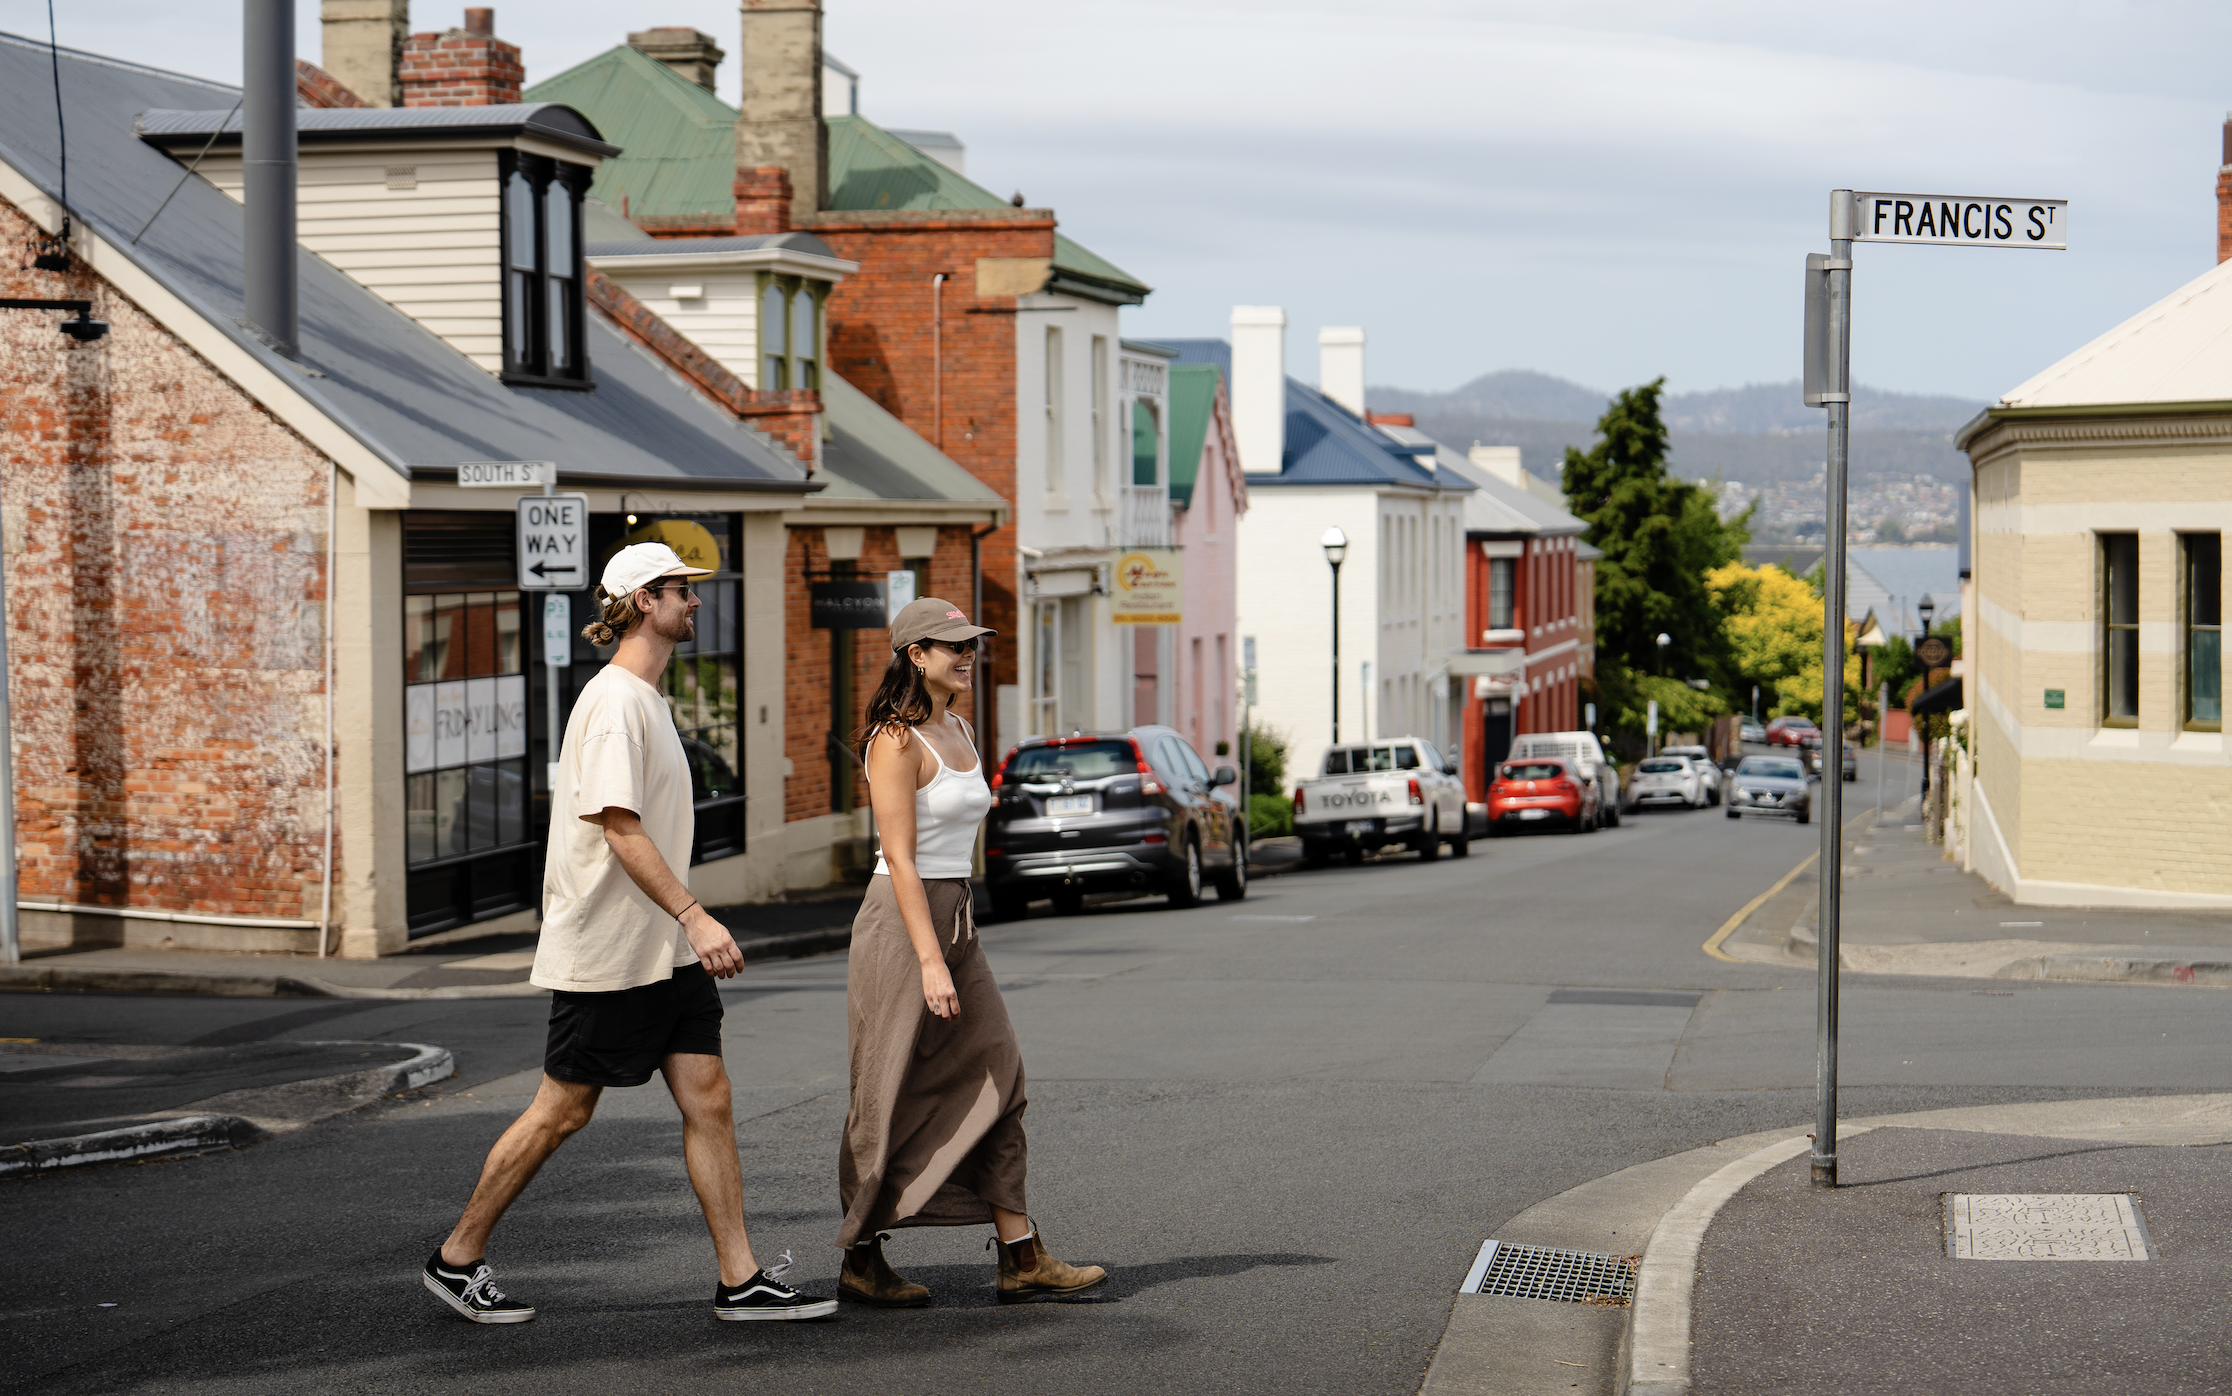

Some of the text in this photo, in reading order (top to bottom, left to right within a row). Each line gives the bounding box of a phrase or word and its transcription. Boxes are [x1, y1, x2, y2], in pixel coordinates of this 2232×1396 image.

[1874, 199, 2057, 241] FRANCIS ST
[462, 464, 515, 482] SOUTH
[528, 506, 574, 526] ONE
[526, 534, 577, 554] WAY
[892, 576, 910, 590] 2P
[813, 597, 886, 608] HALCYON
[1321, 789, 1392, 808] TOYOTA
